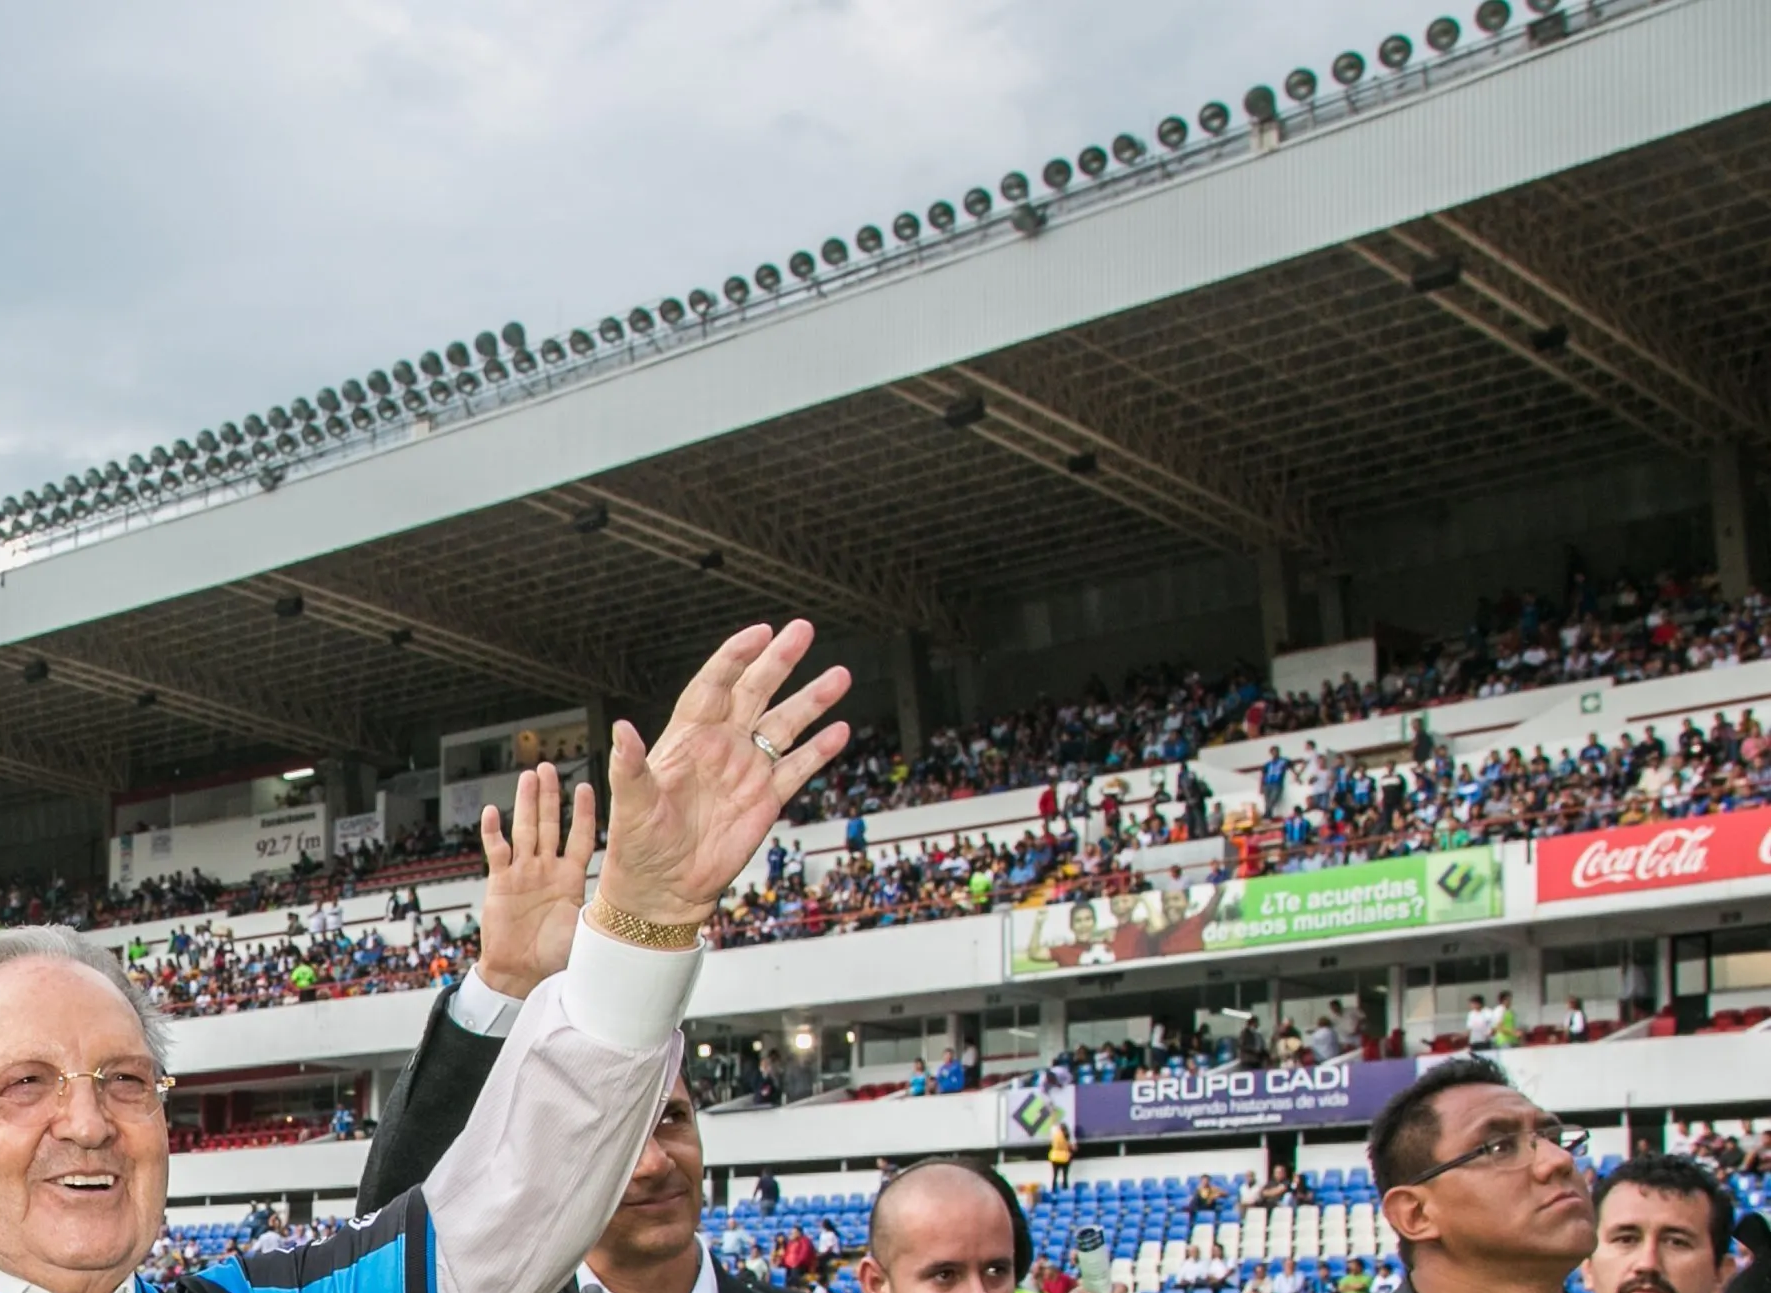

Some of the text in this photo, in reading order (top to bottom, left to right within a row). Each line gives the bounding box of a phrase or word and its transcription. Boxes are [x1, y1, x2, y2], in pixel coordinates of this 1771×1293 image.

[1572, 825, 1715, 888] Coca-Cola
[1260, 878, 1418, 915] ¿Te acuerdas
[1202, 896, 1425, 942] de esos mundiales?
[1131, 1063, 1350, 1104] GRUPO CADI
[1130, 1091, 1349, 1122] Construyendo historias de vida
